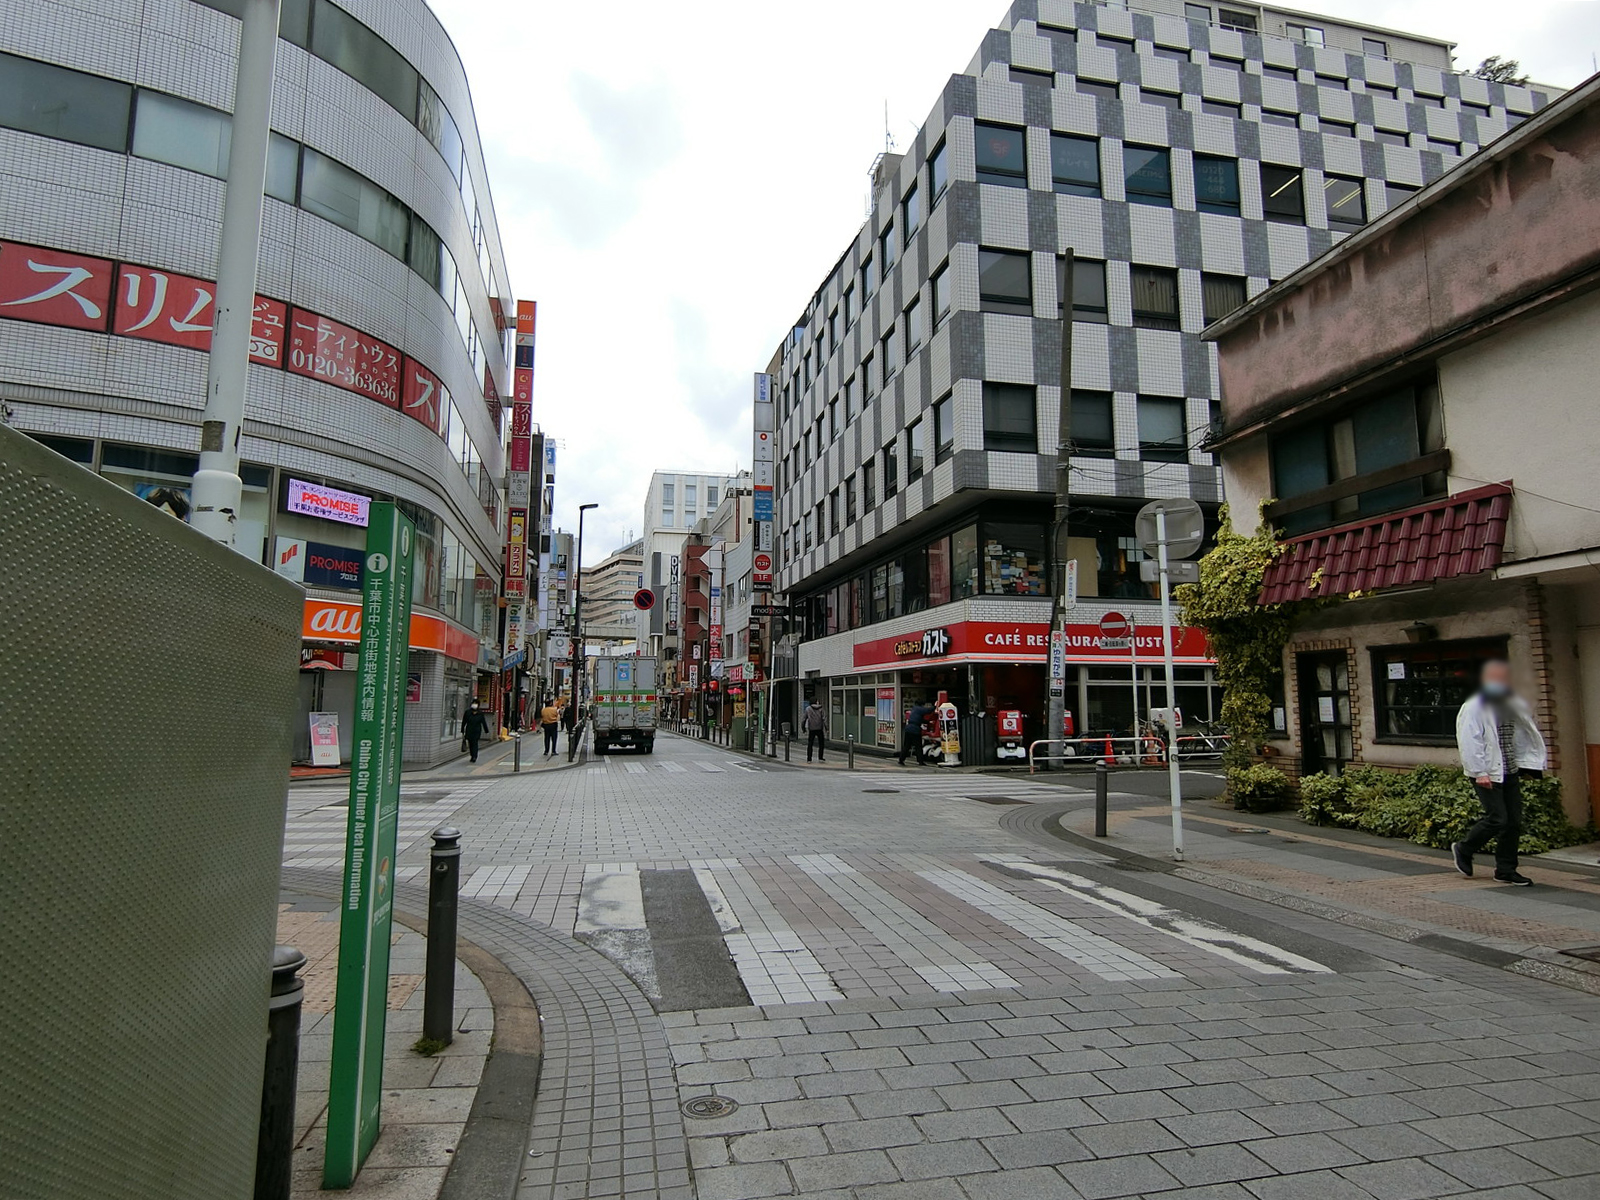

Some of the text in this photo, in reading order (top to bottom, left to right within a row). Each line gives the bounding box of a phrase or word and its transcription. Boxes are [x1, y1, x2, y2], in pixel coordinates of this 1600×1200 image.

[292, 349, 396, 402] 0120-363636
[519, 404, 531, 436] スリム
[302, 492, 358, 515] PROMISE
[310, 555, 360, 574] PROMISE
[512, 547, 520, 574] カラオケ
[340, 572, 358, 581] プロミス
[310, 608, 361, 635] au
[361, 578, 383, 722] 千葉市中心市街地案内情報
[923, 629, 948, 656] ガスト
[984, 629, 1021, 647] CAFÉ
[1053, 649, 1061, 677] ゆたかや
[348, 739, 372, 910] Chiba City Inner Area Information
